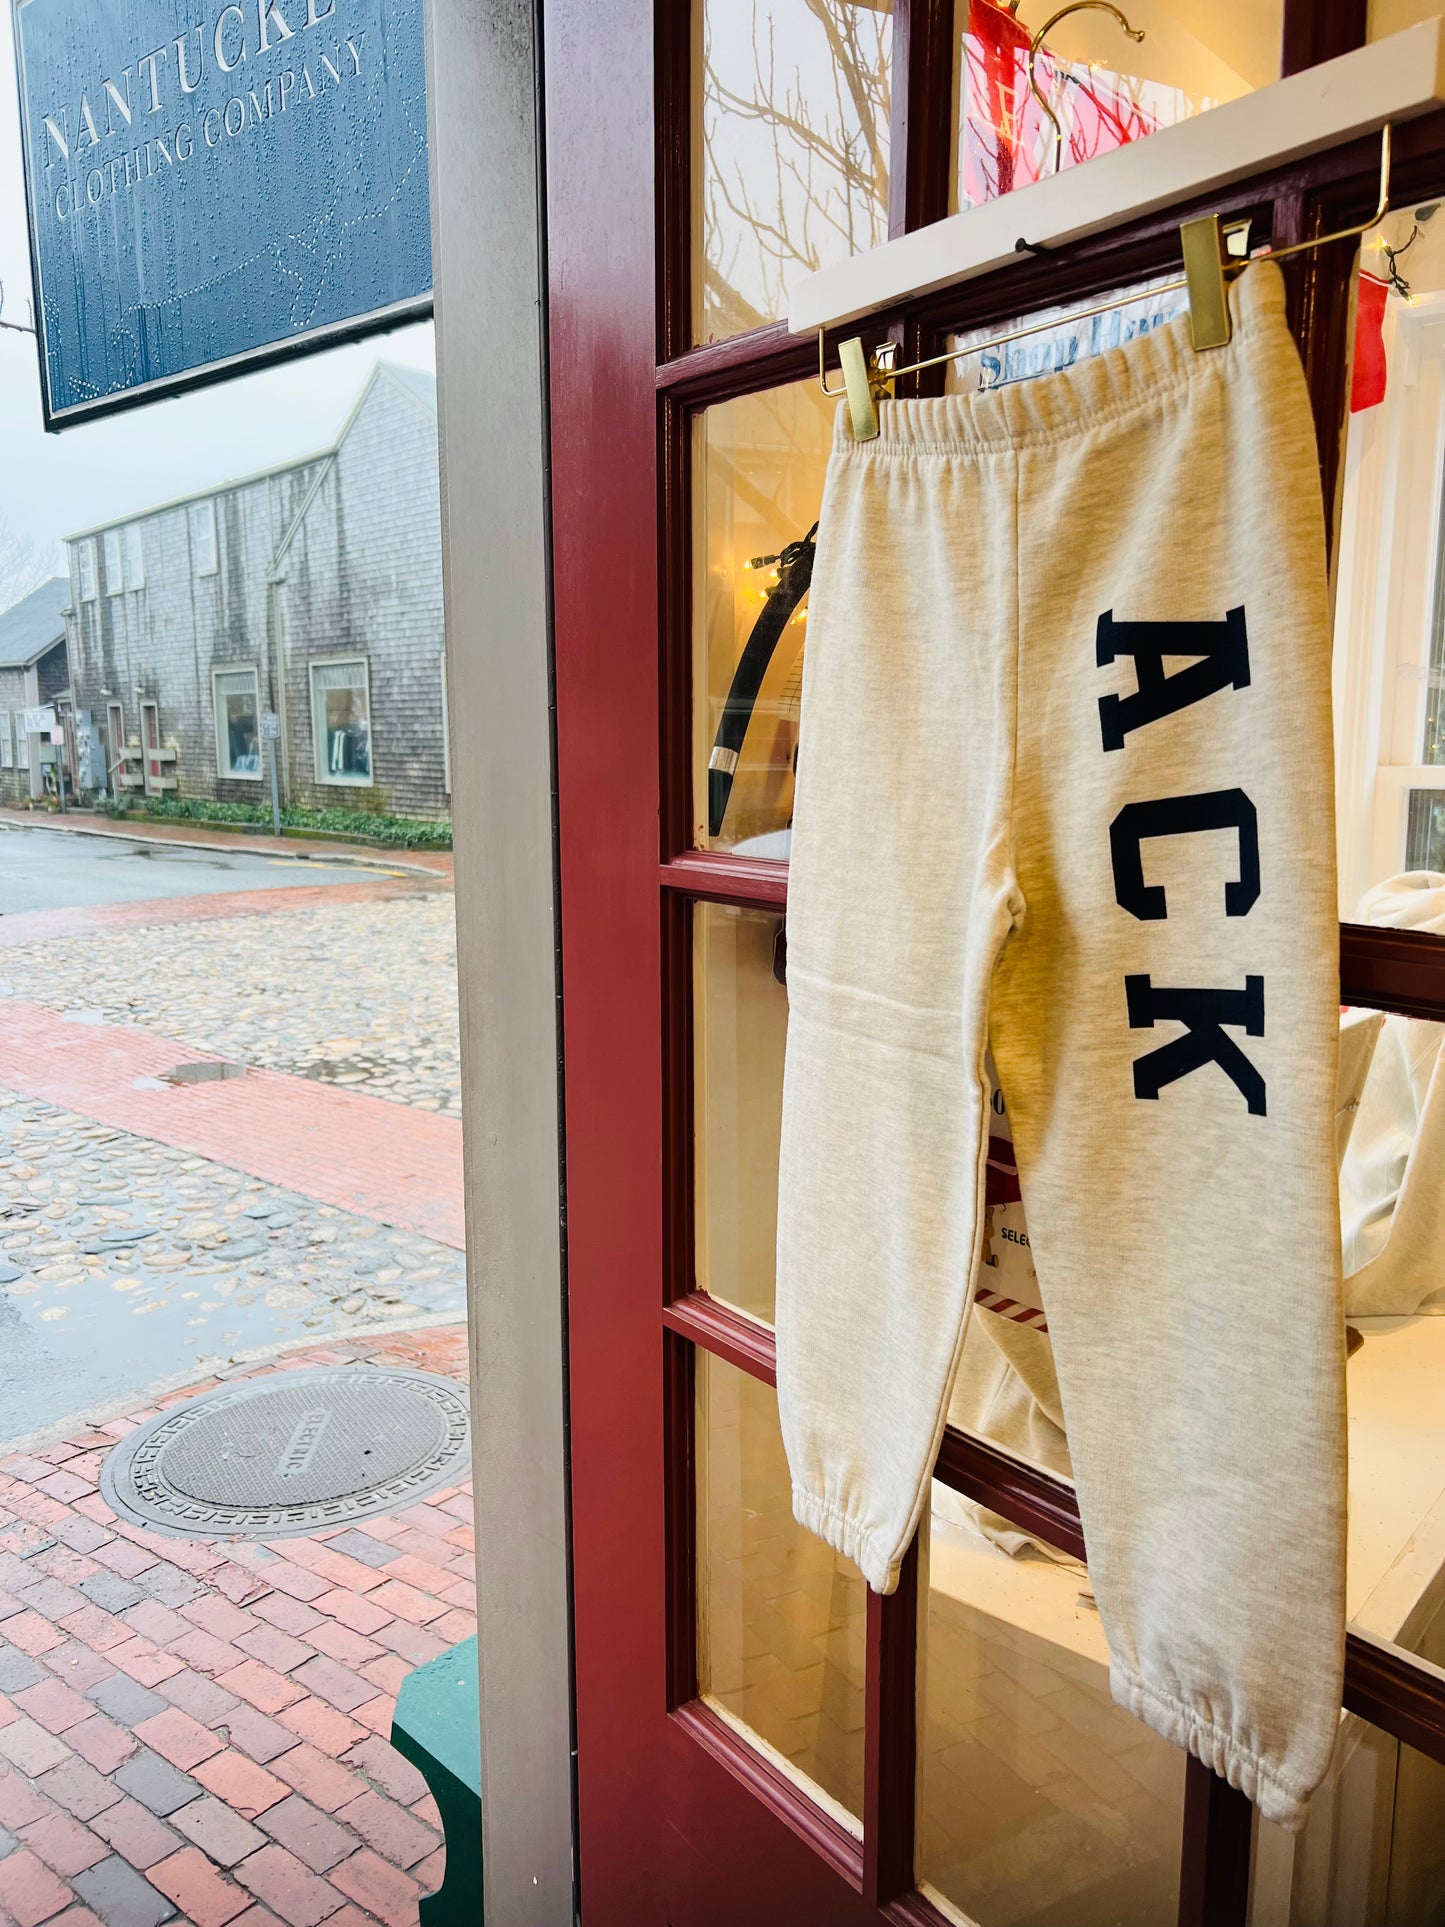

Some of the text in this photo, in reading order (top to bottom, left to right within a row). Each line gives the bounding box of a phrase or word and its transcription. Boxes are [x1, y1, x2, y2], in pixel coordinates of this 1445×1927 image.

[55, 31, 366, 220] CLOTHING COMPANY
[1095, 604, 1267, 1118] ACK
[286, 1413, 326, 1469] ELECTRIC
